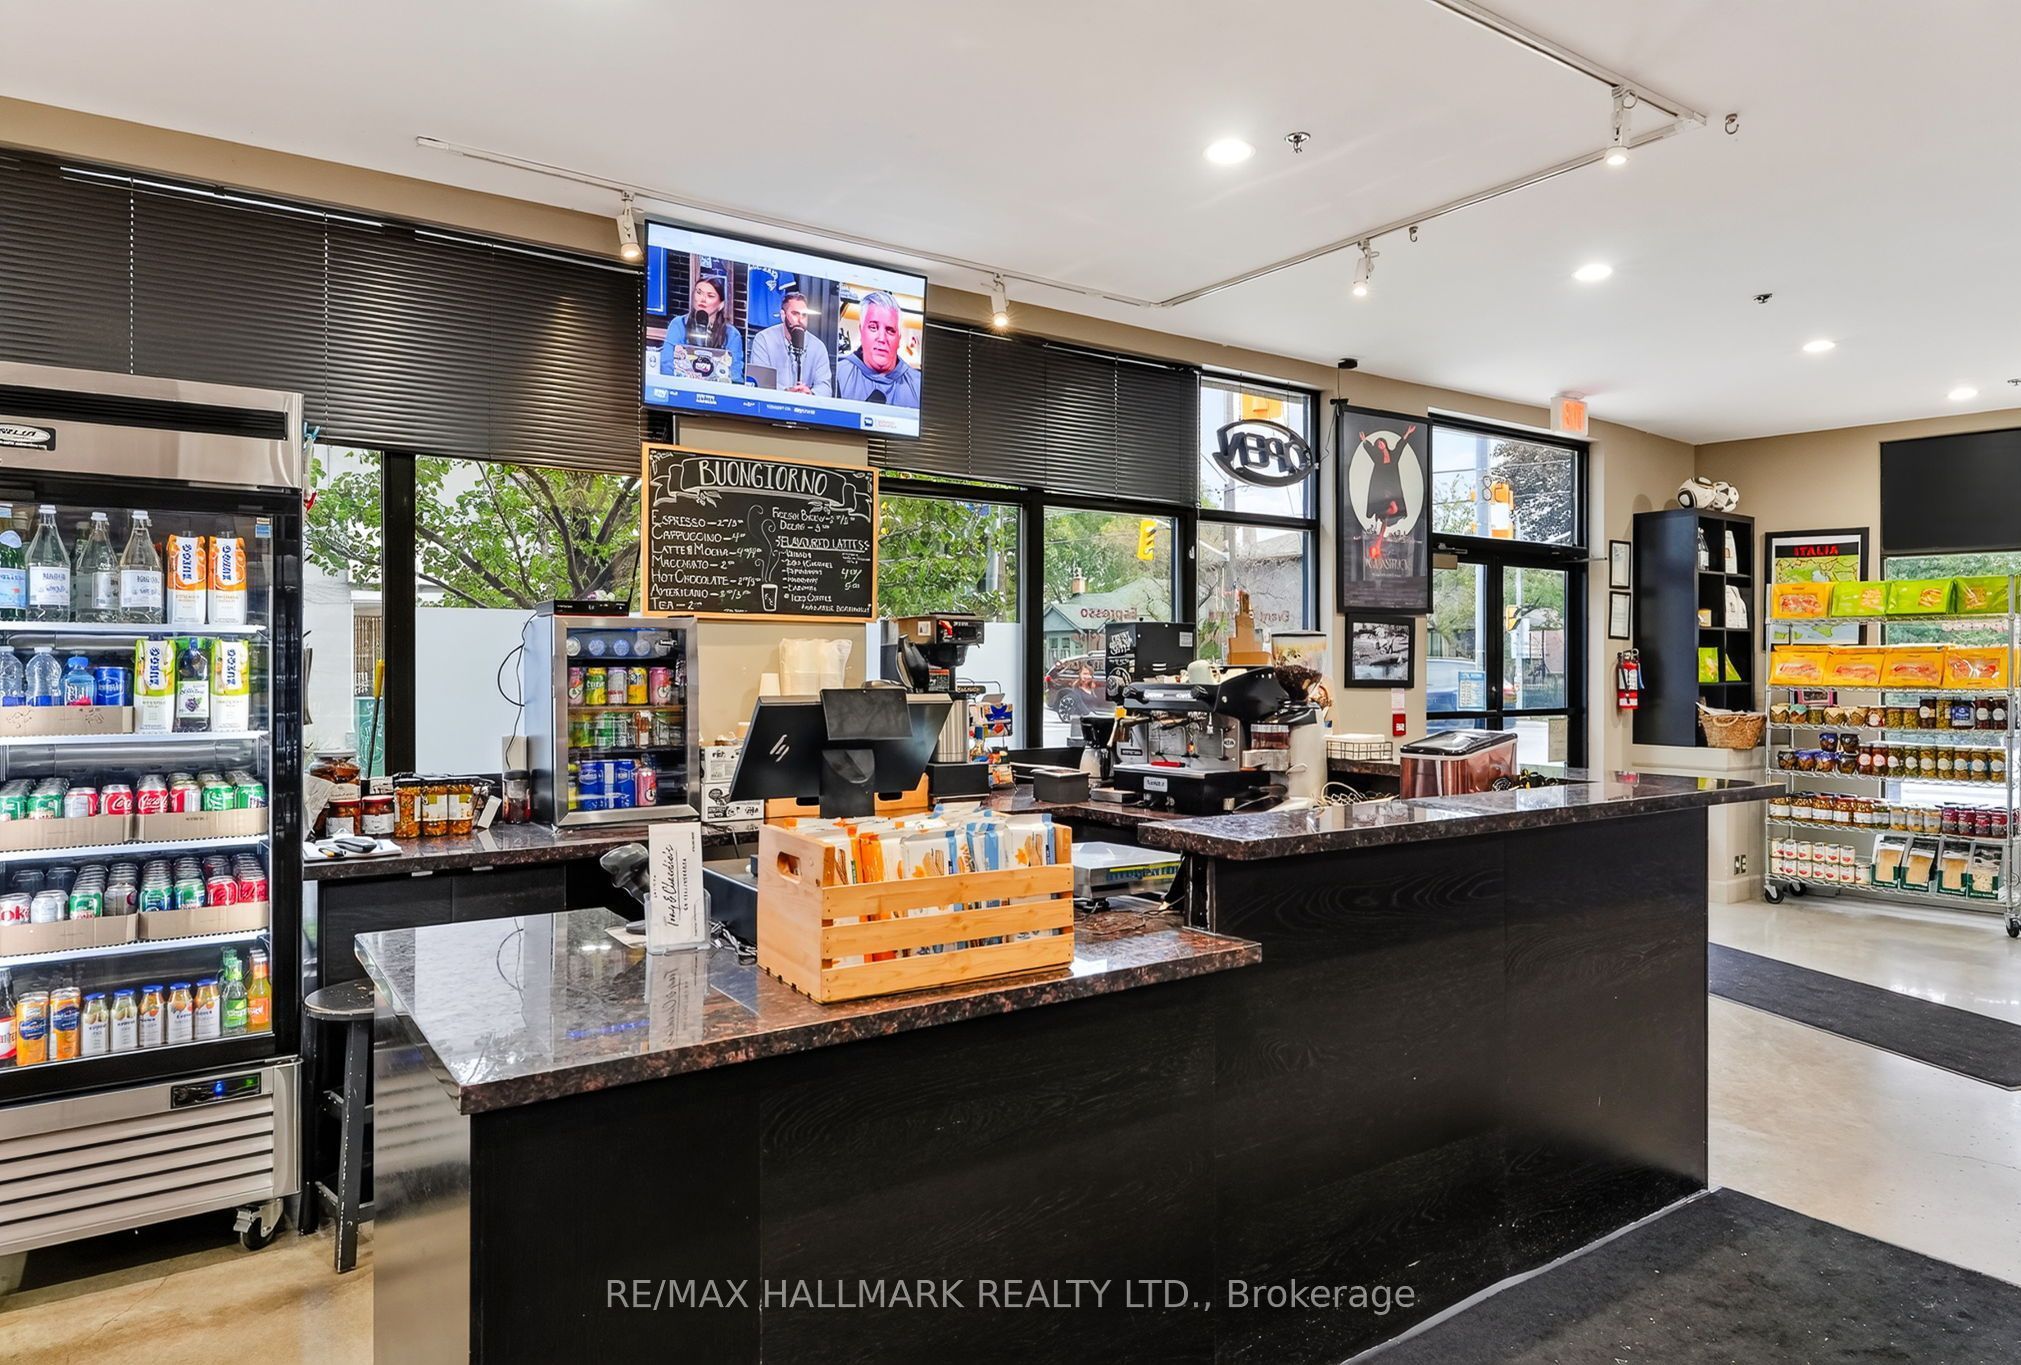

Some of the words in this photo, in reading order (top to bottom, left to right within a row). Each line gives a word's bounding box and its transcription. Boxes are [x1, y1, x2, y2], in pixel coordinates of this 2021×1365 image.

[699, 461, 828, 496] BUONGIORNO
[651, 509, 705, 527] ESPRESSO
[651, 524, 722, 542] CAPPUCCINO
[651, 540, 685, 555] LATTE
[1794, 545, 1839, 556] ITALIA
[651, 568, 674, 583] HOT
[675, 570, 729, 585] CHOCOLATE
[650, 597, 674, 610] TEA
